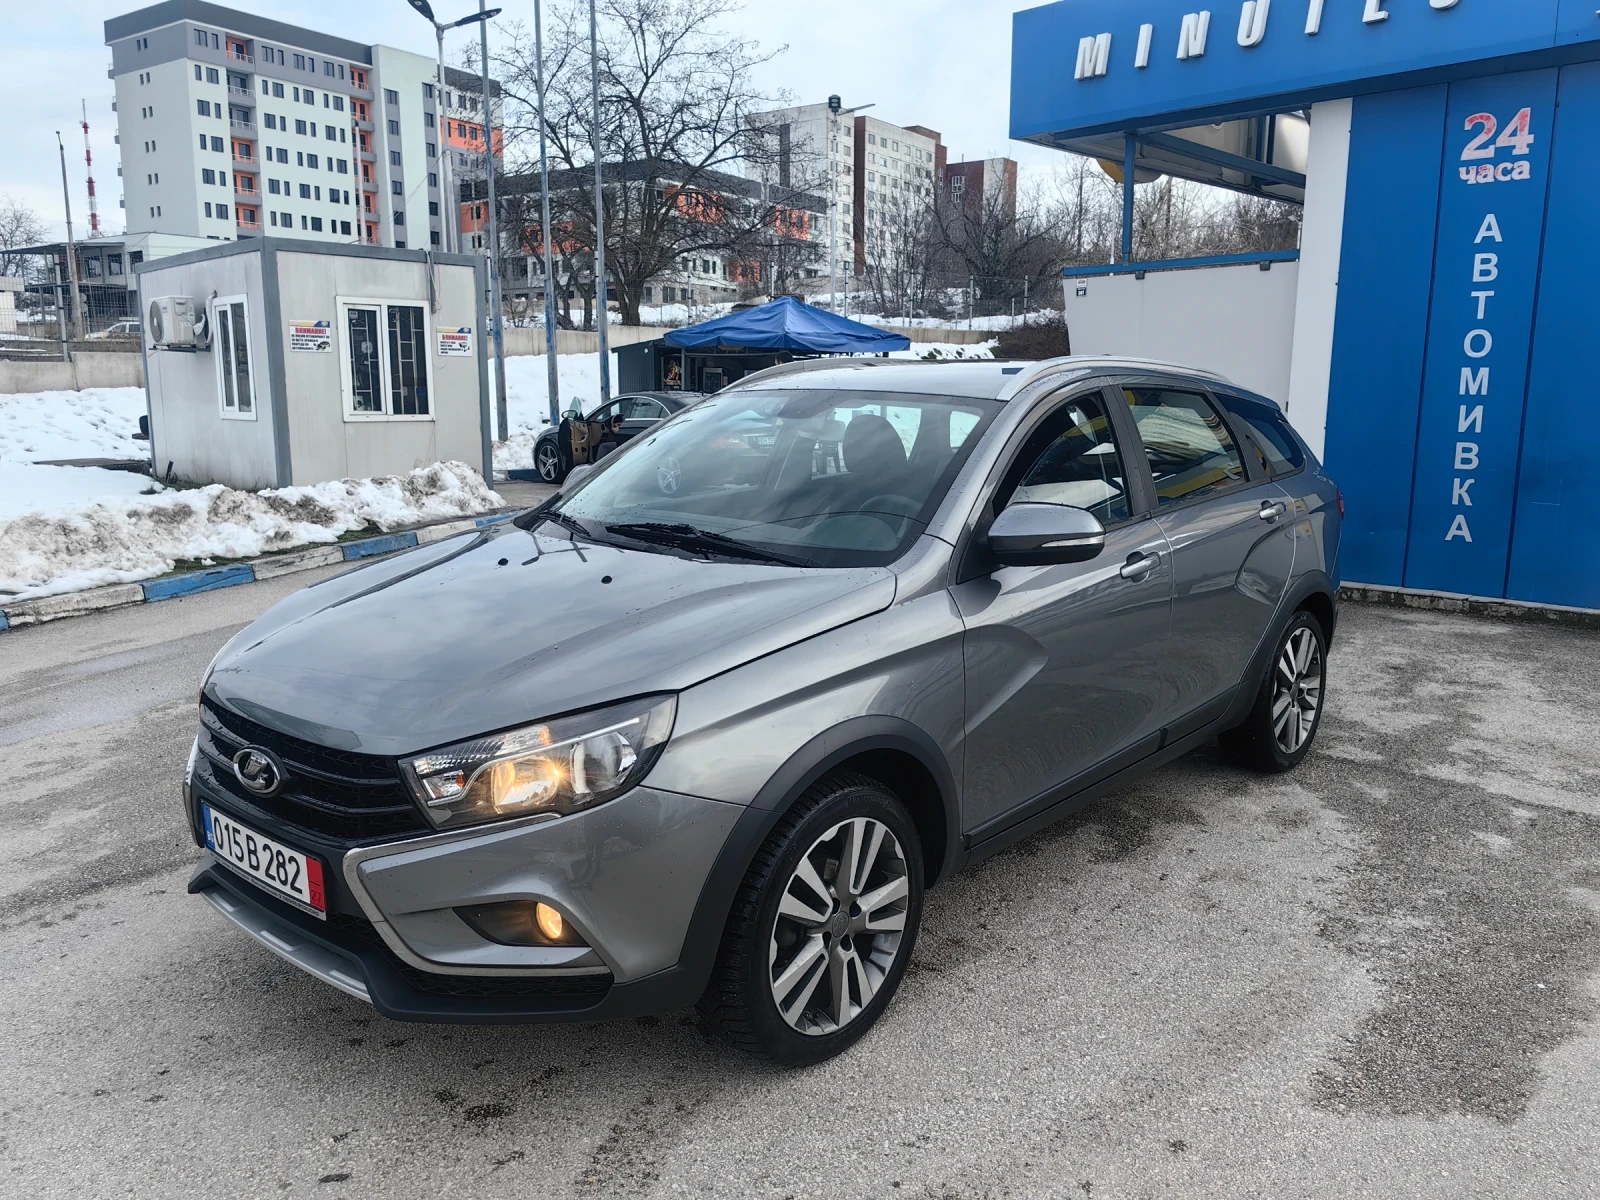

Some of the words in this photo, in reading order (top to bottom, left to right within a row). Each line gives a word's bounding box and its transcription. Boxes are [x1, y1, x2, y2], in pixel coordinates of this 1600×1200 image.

[1460, 107, 1535, 161] 24
[1459, 160, 1531, 185] часа
[1444, 213, 1503, 543] АВТОМИВКА
